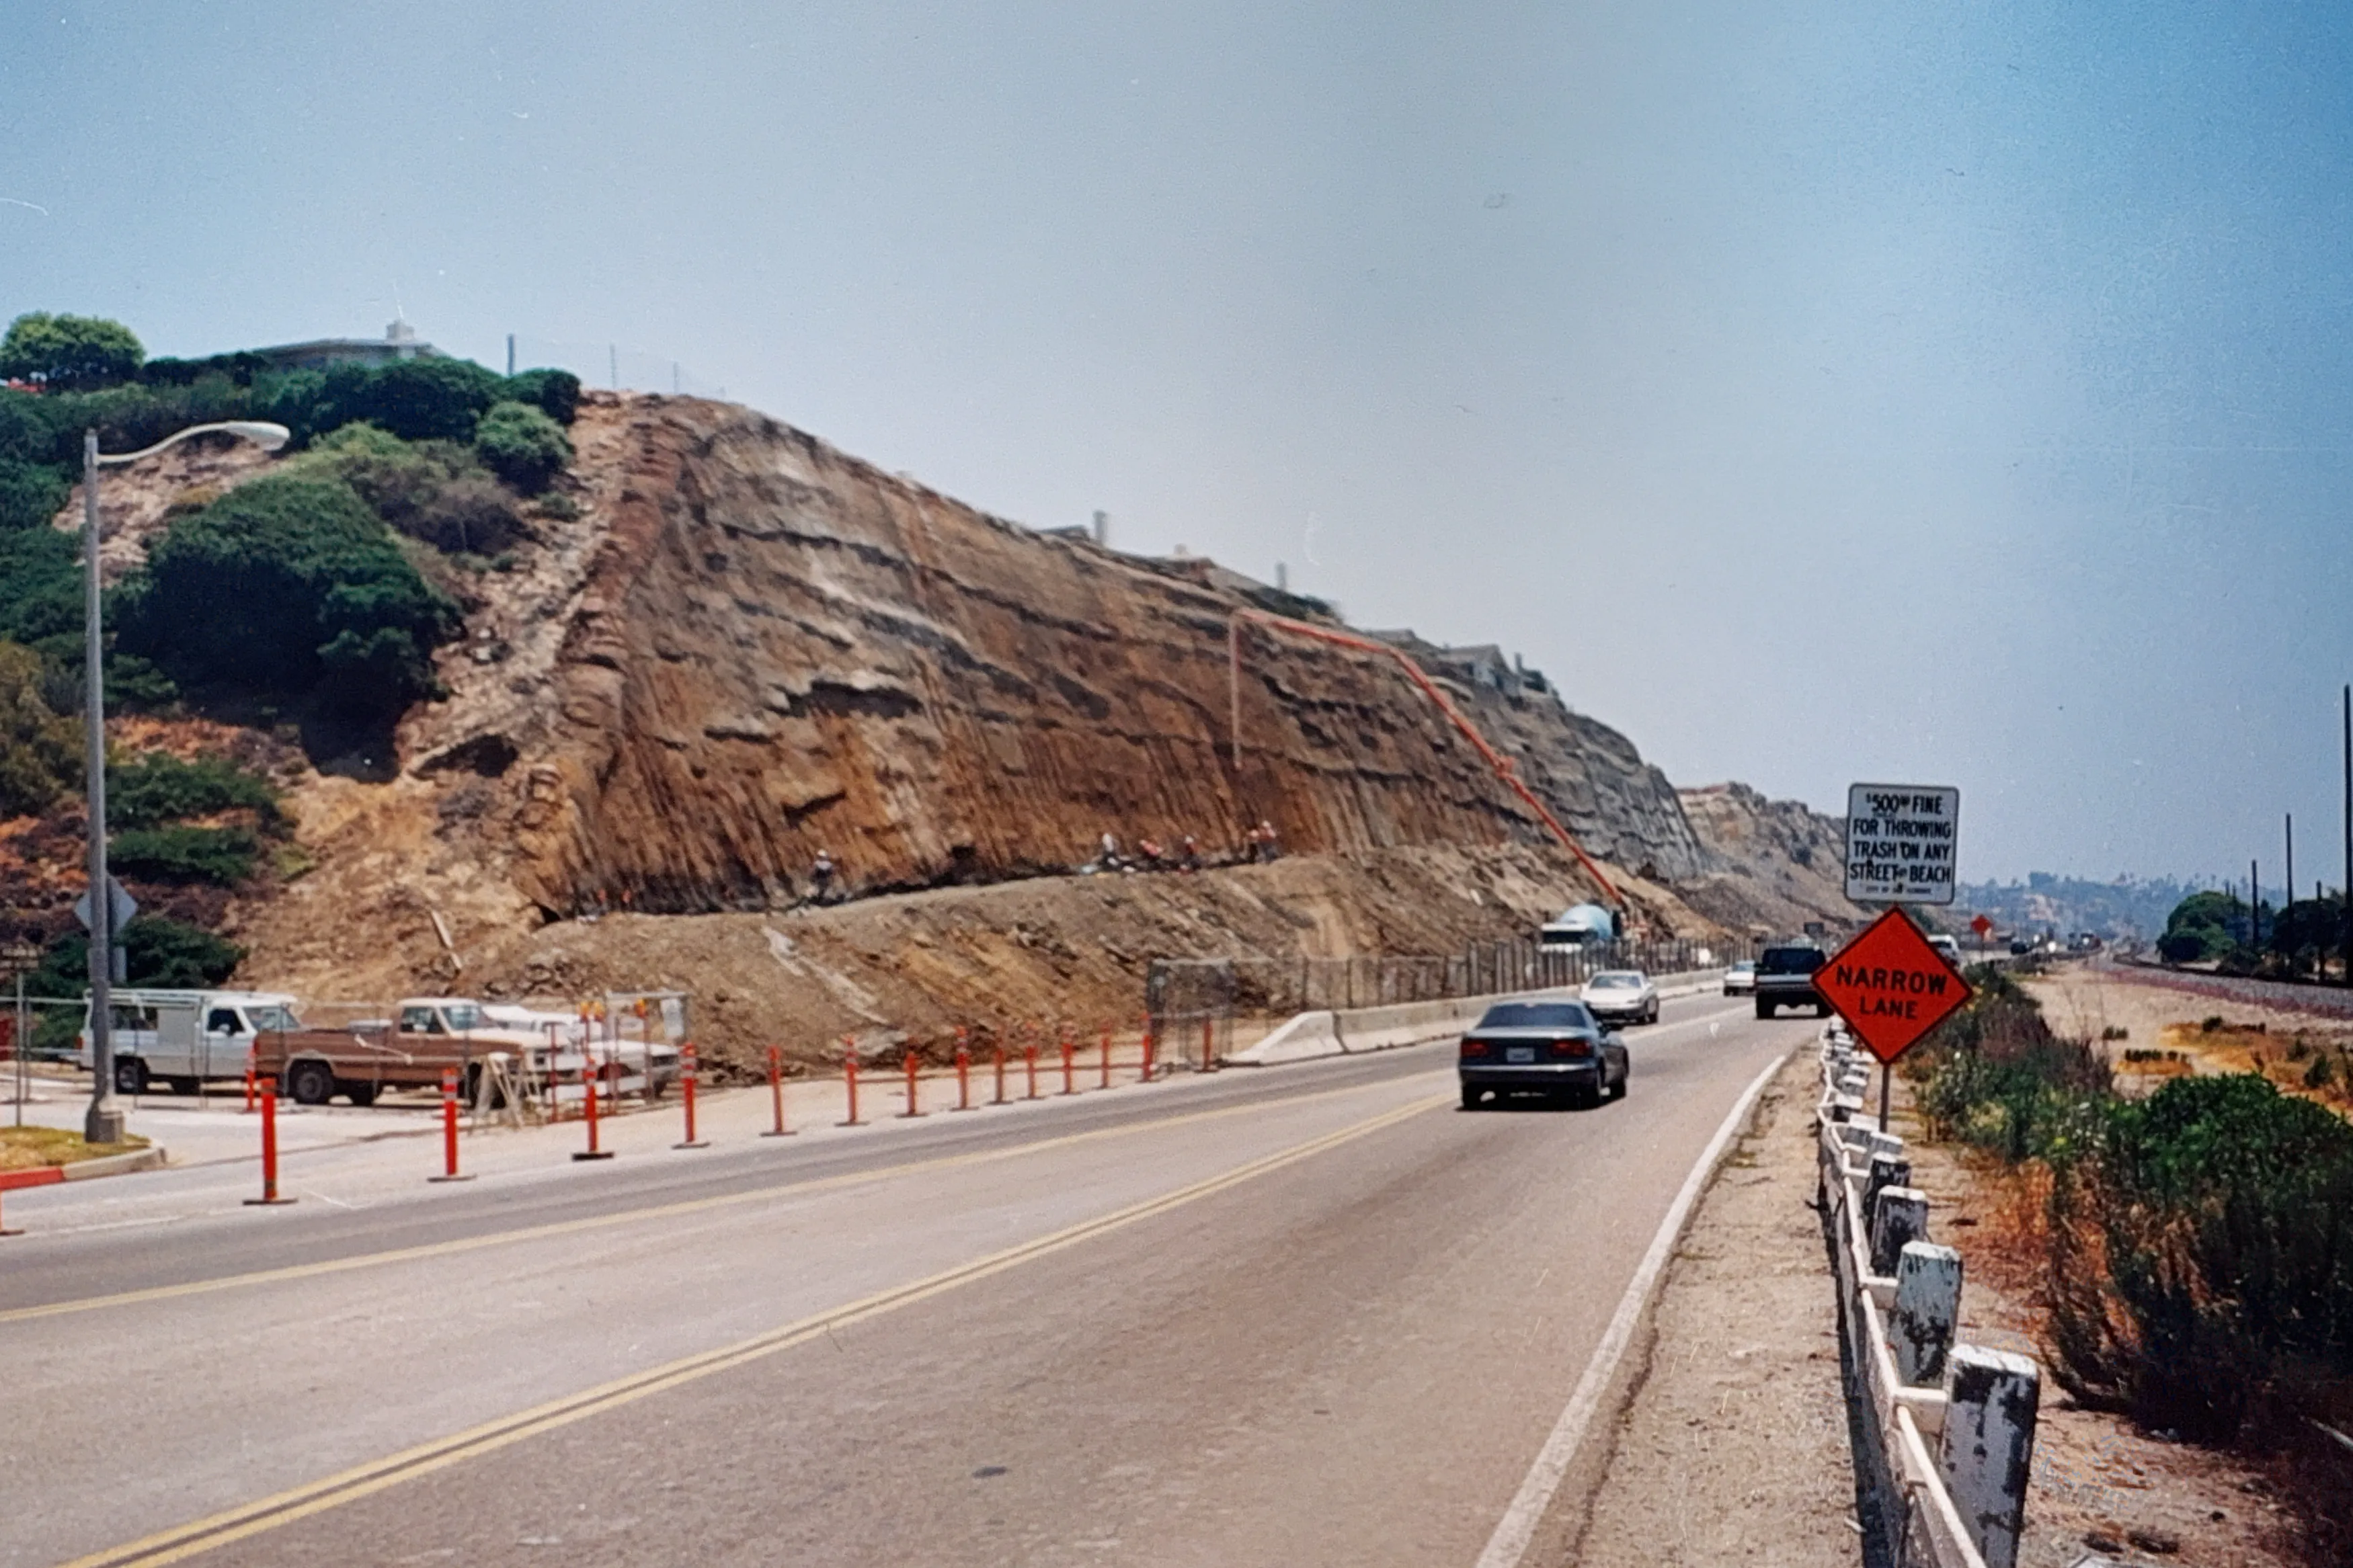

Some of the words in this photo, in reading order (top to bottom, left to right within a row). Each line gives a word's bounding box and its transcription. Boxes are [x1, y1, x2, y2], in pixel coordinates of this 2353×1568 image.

[1912, 795, 1943, 815] FINE
[1853, 818, 1879, 836] FOR
[1884, 819, 1951, 839] THROWING
[1853, 841, 1897, 859] TRASH
[1924, 843, 1950, 860] ANY
[1850, 863, 1899, 881] STREET
[1909, 865, 1951, 882] BEACH
[1835, 965, 1948, 995] NARROW
[1860, 996, 1918, 1020] LANE
